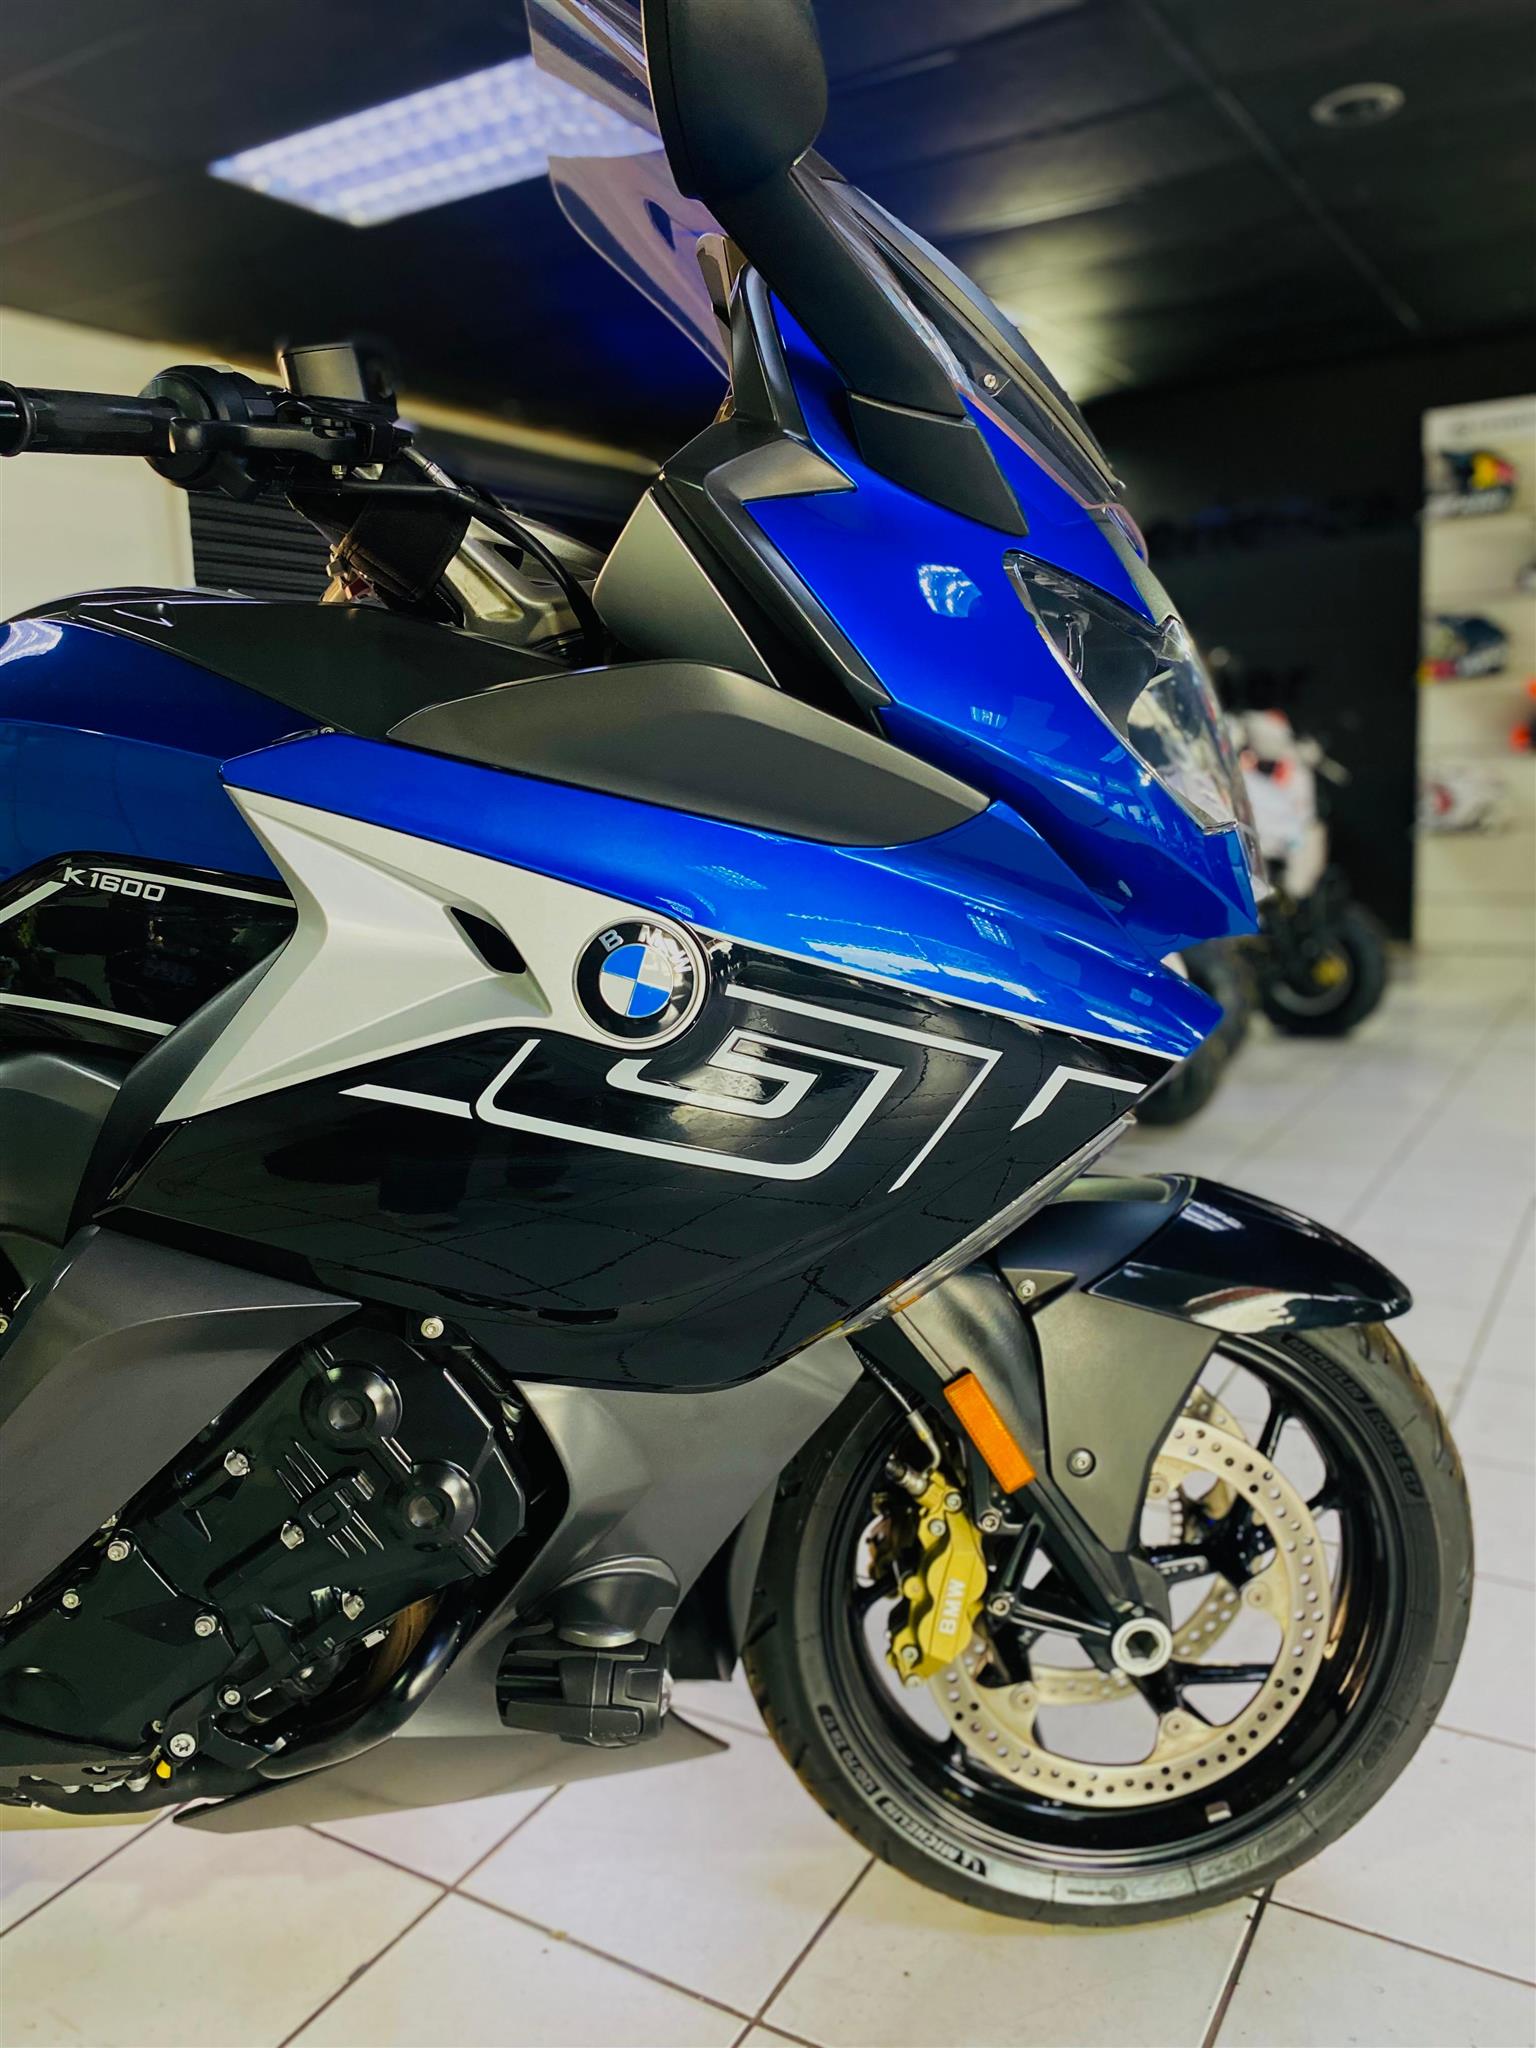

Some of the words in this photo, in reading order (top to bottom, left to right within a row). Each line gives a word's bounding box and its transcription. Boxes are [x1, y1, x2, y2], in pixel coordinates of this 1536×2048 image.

[63, 866, 166, 902] K1600
[598, 924, 692, 973] BMW
[1289, 1337, 1366, 1402] MICHELIN
[1369, 1411, 1402, 1455] ROAD
[939, 1578, 966, 1636] BMW
[881, 1801, 960, 1862] MICHELIN
